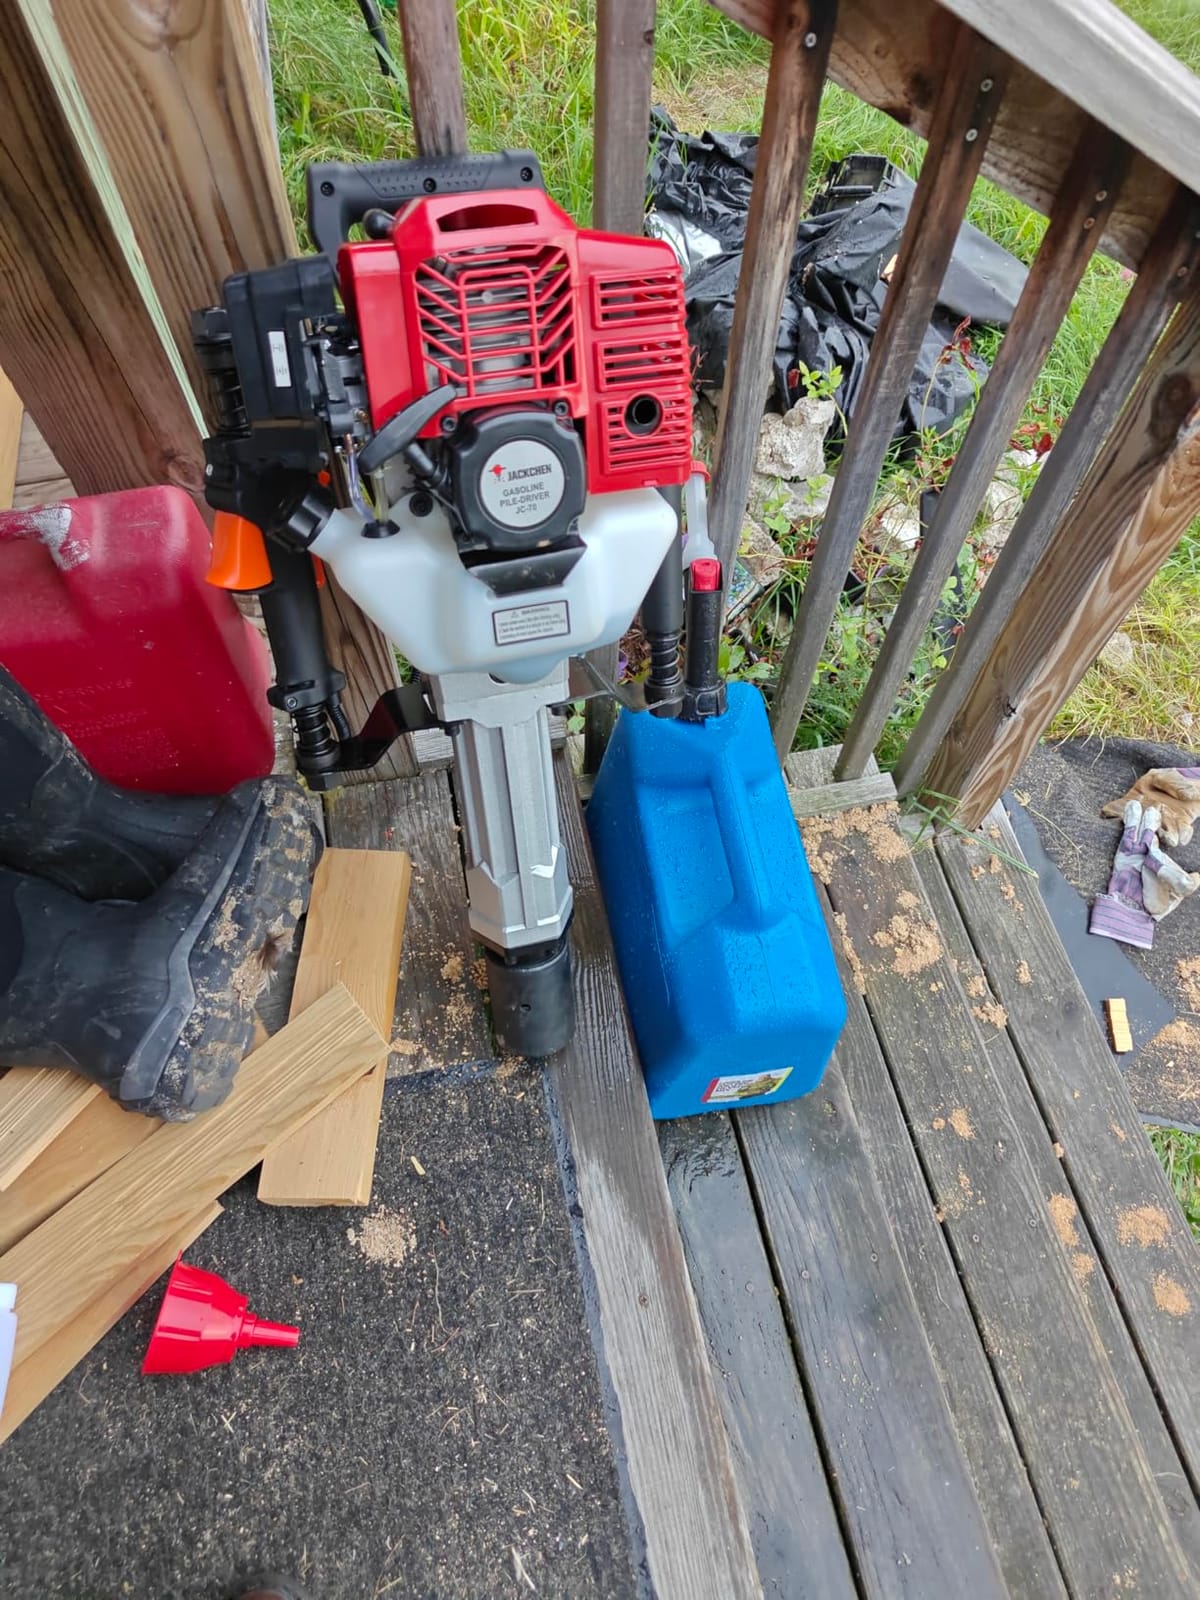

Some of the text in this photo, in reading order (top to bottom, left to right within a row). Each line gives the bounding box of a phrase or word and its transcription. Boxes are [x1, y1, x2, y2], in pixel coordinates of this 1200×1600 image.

[508, 464, 552, 481] JACKCHEN
[502, 482, 545, 497] GASOLINE
[500, 491, 550, 507] PILE-DRIVER
